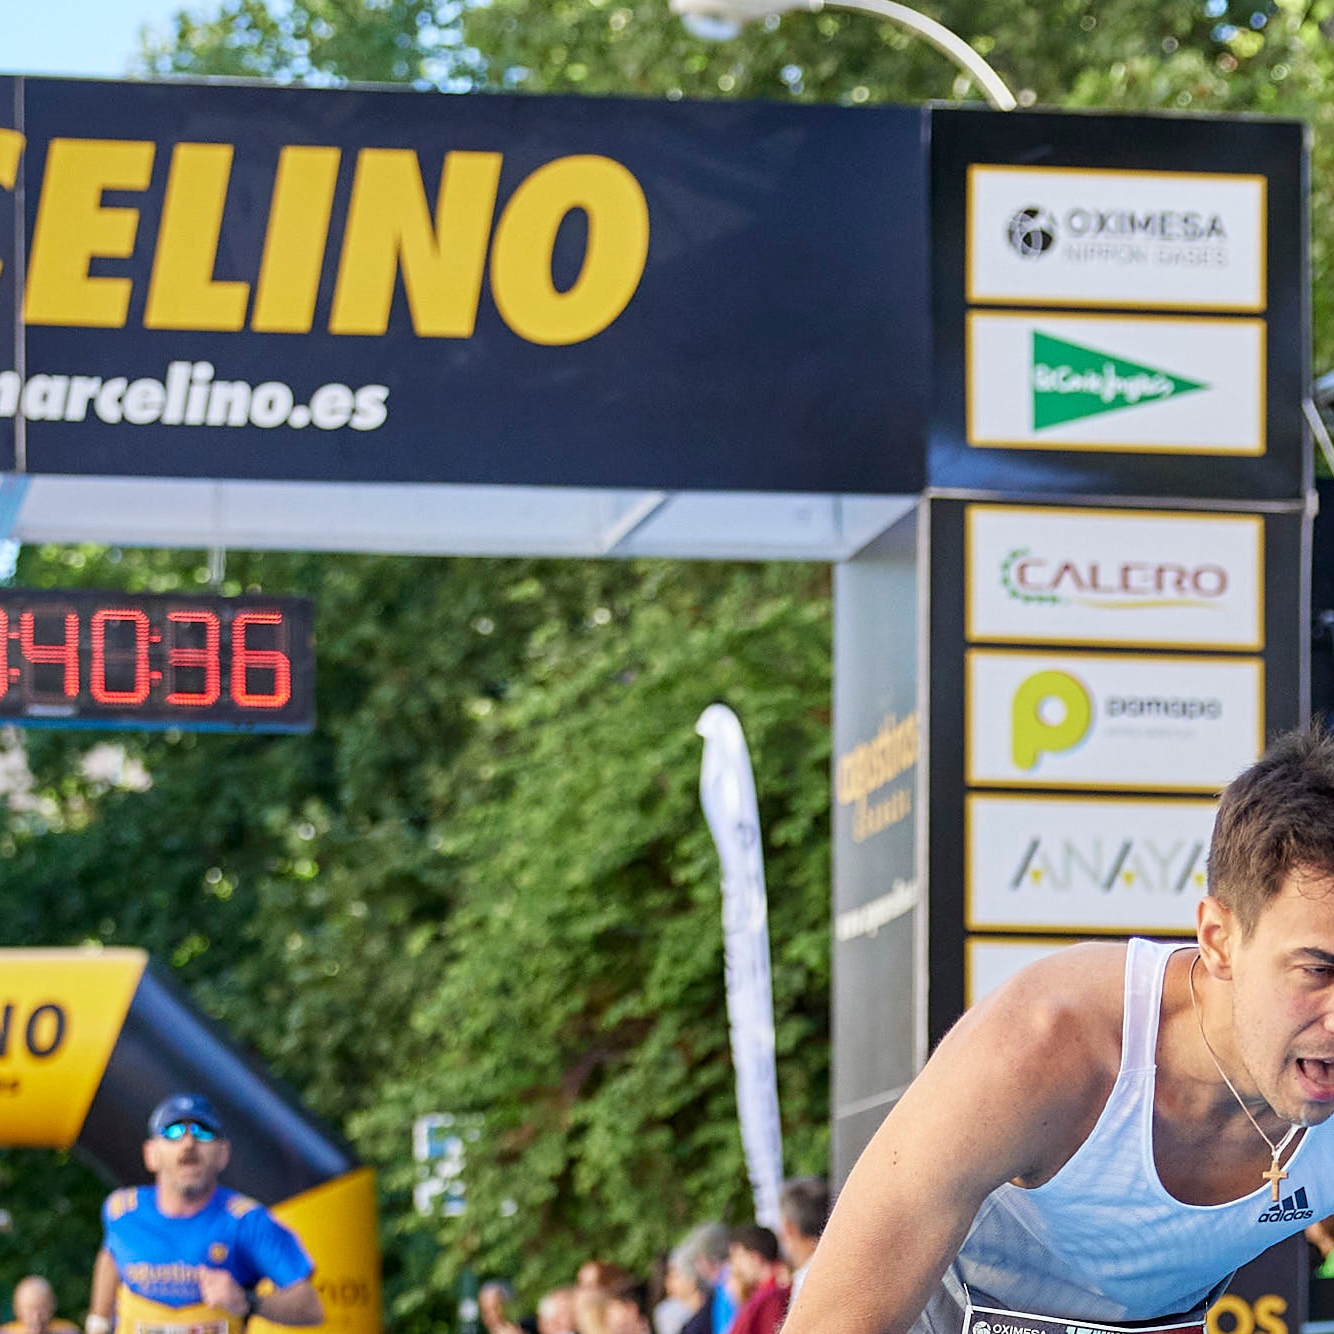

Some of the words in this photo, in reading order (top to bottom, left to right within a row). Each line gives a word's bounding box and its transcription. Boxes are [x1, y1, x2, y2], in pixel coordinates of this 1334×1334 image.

[1064, 207, 1228, 241] OXIMESA
[1015, 559, 1228, 598] CALERO
[1258, 1209, 1314, 1223] adidas
